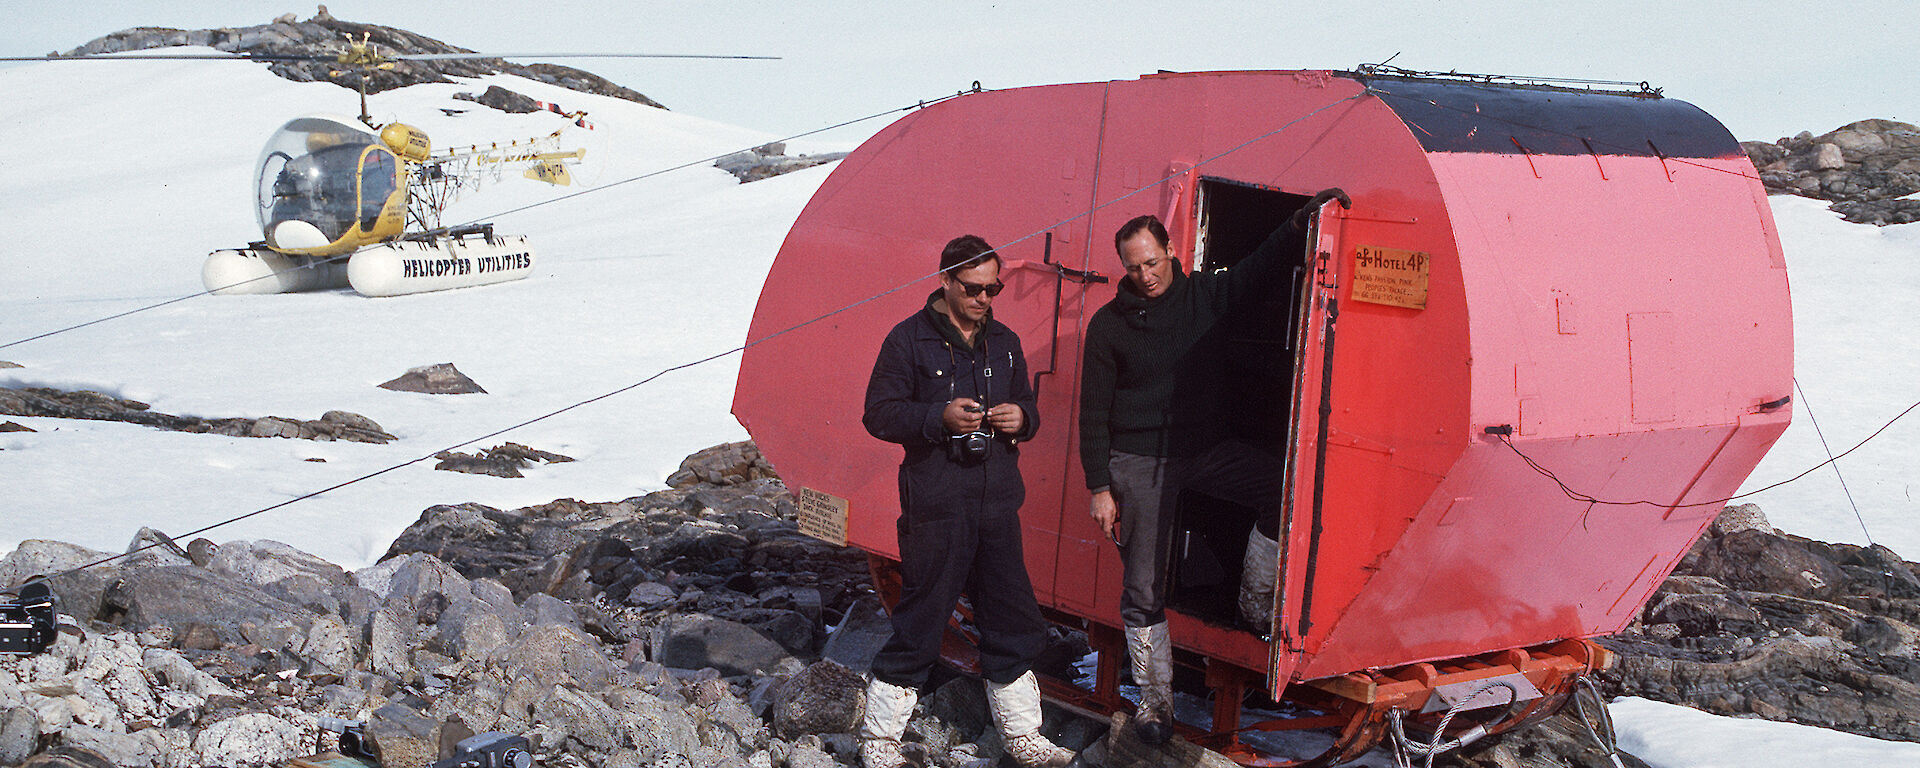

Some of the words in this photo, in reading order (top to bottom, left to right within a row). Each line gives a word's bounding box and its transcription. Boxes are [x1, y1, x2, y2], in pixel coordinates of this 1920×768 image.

[403, 258, 471, 278] HELICOPTER
[478, 252, 531, 274] UTILITIES
[1407, 254, 1424, 272] 4P
